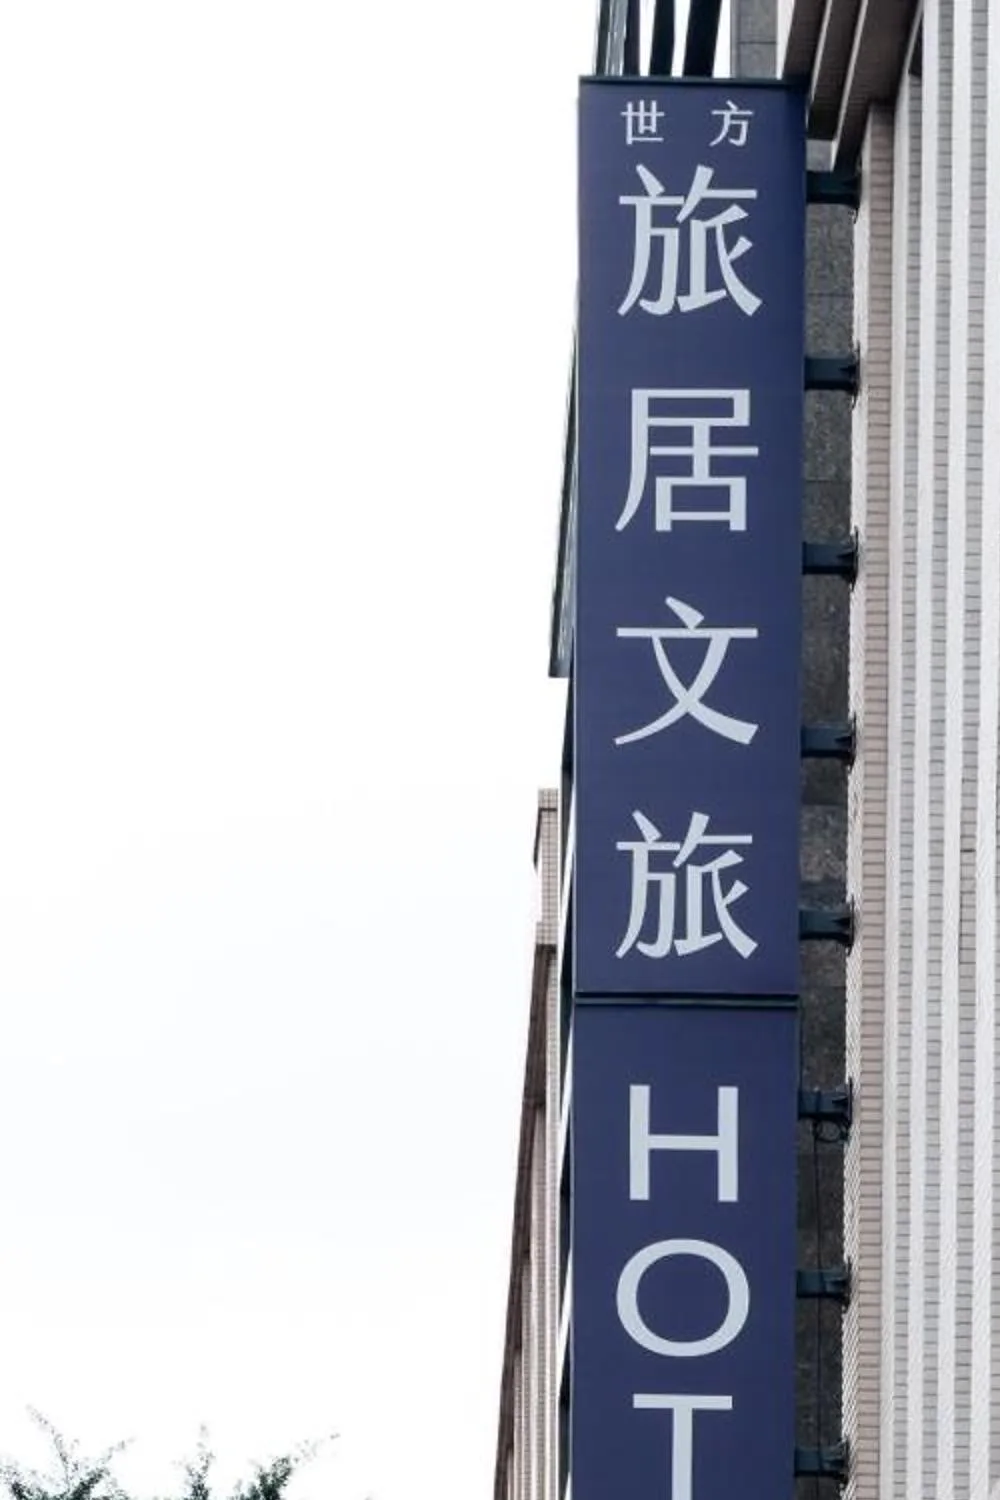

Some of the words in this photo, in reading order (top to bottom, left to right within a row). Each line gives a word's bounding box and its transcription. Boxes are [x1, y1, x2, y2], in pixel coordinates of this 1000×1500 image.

[620, 100, 754, 147] 世方
[614, 163, 763, 960] 旅居文旅
